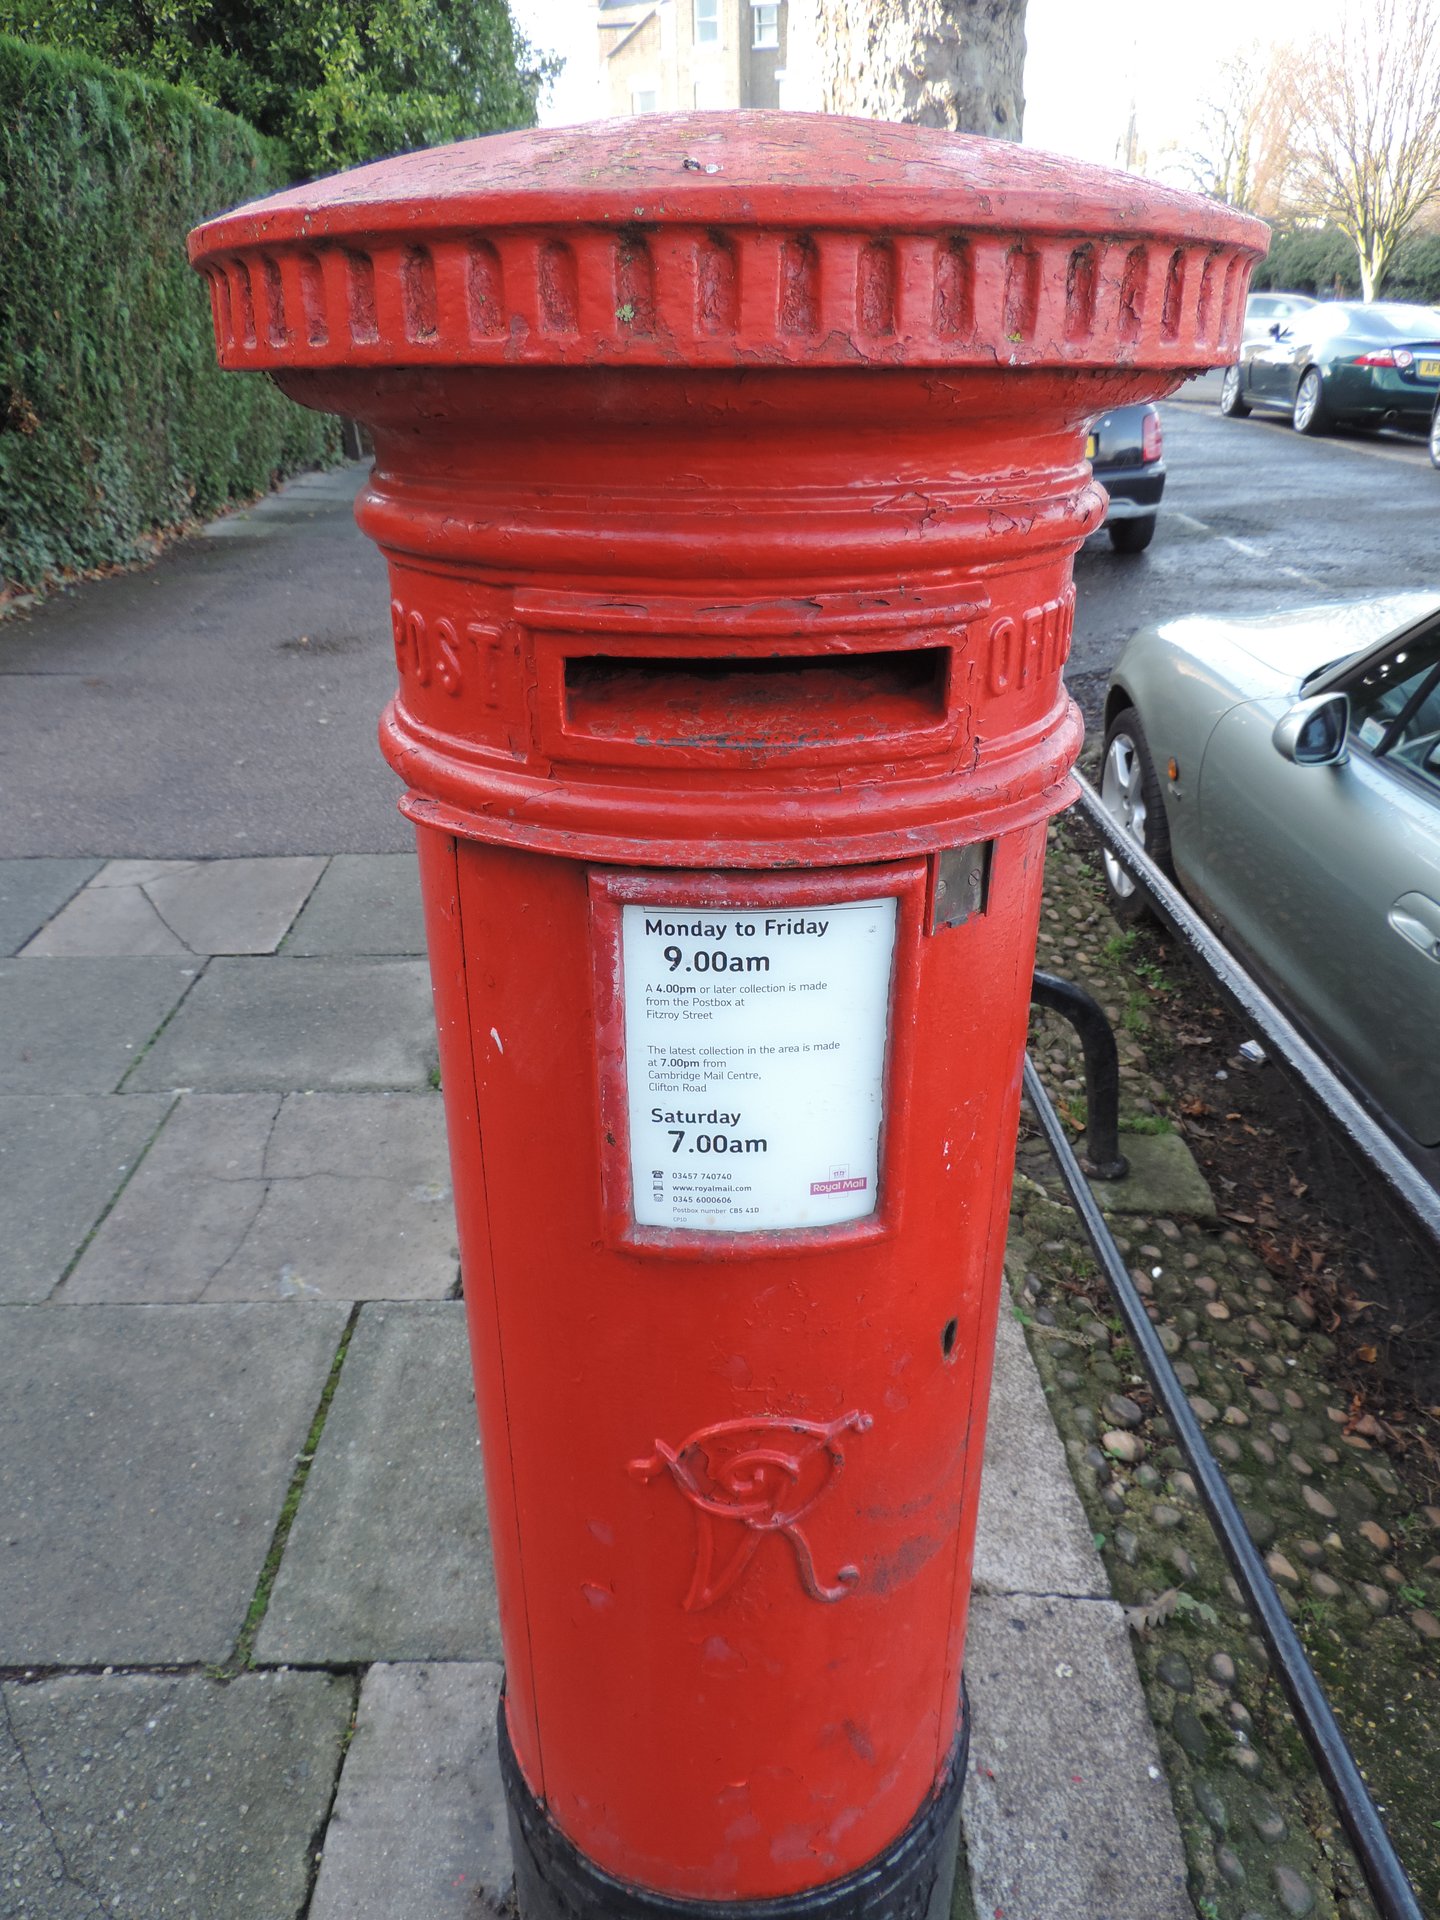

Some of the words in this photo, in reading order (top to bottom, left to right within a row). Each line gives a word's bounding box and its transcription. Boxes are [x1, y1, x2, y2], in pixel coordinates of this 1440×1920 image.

[391, 599, 502, 708] POST
[646, 919, 727, 940] Monday
[735, 922, 755, 936] to
[765, 918, 829, 937] Friday
[664, 946, 770, 972] 9.00am
[646, 983, 653, 993] A
[656, 984, 696, 995] 4.00pm
[700, 986, 710, 995] or
[714, 984, 736, 995] later
[740, 983, 785, 994] collection
[789, 982, 796, 992] is
[800, 981, 827, 991] made
[646, 996, 669, 1007] from
[673, 997, 689, 1007] the
[693, 997, 732, 1008] Postbox
[735, 997, 745, 1007] at
[646, 1010, 679, 1020] Fitzroy
[682, 1009, 713, 1020] Street
[647, 1044, 666, 1055] The
[670, 1045, 696, 1056] latest
[699, 1045, 744, 1056] collection
[748, 1045, 756, 1055] in
[759, 1044, 775, 1055] the
[778, 1044, 799, 1054] area
[803, 1042, 810, 1053] is
[814, 1041, 840, 1051] made
[648, 1058, 657, 1068] at
[660, 1058, 699, 1069] 7.00pm
[703, 1058, 726, 1068] from
[648, 1070, 700, 1081] Cambridge
[704, 1070, 724, 1081] Mail
[648, 1082, 679, 1092] Clifton
[682, 1082, 707, 1092] Road
[651, 1108, 741, 1127] Saturday
[668, 1130, 767, 1153] 7.00am
[672, 1171, 697, 1180] 03457
[701, 1172, 732, 1181] 740740
[672, 1184, 751, 1194] www.royalmail.com
[813, 1182, 841, 1193] Royal
[842, 1178, 865, 1190] Mail
[673, 1195, 693, 1204] 0345
[696, 1196, 732, 1204] 6000606
[673, 1206, 698, 1214] Postbox
